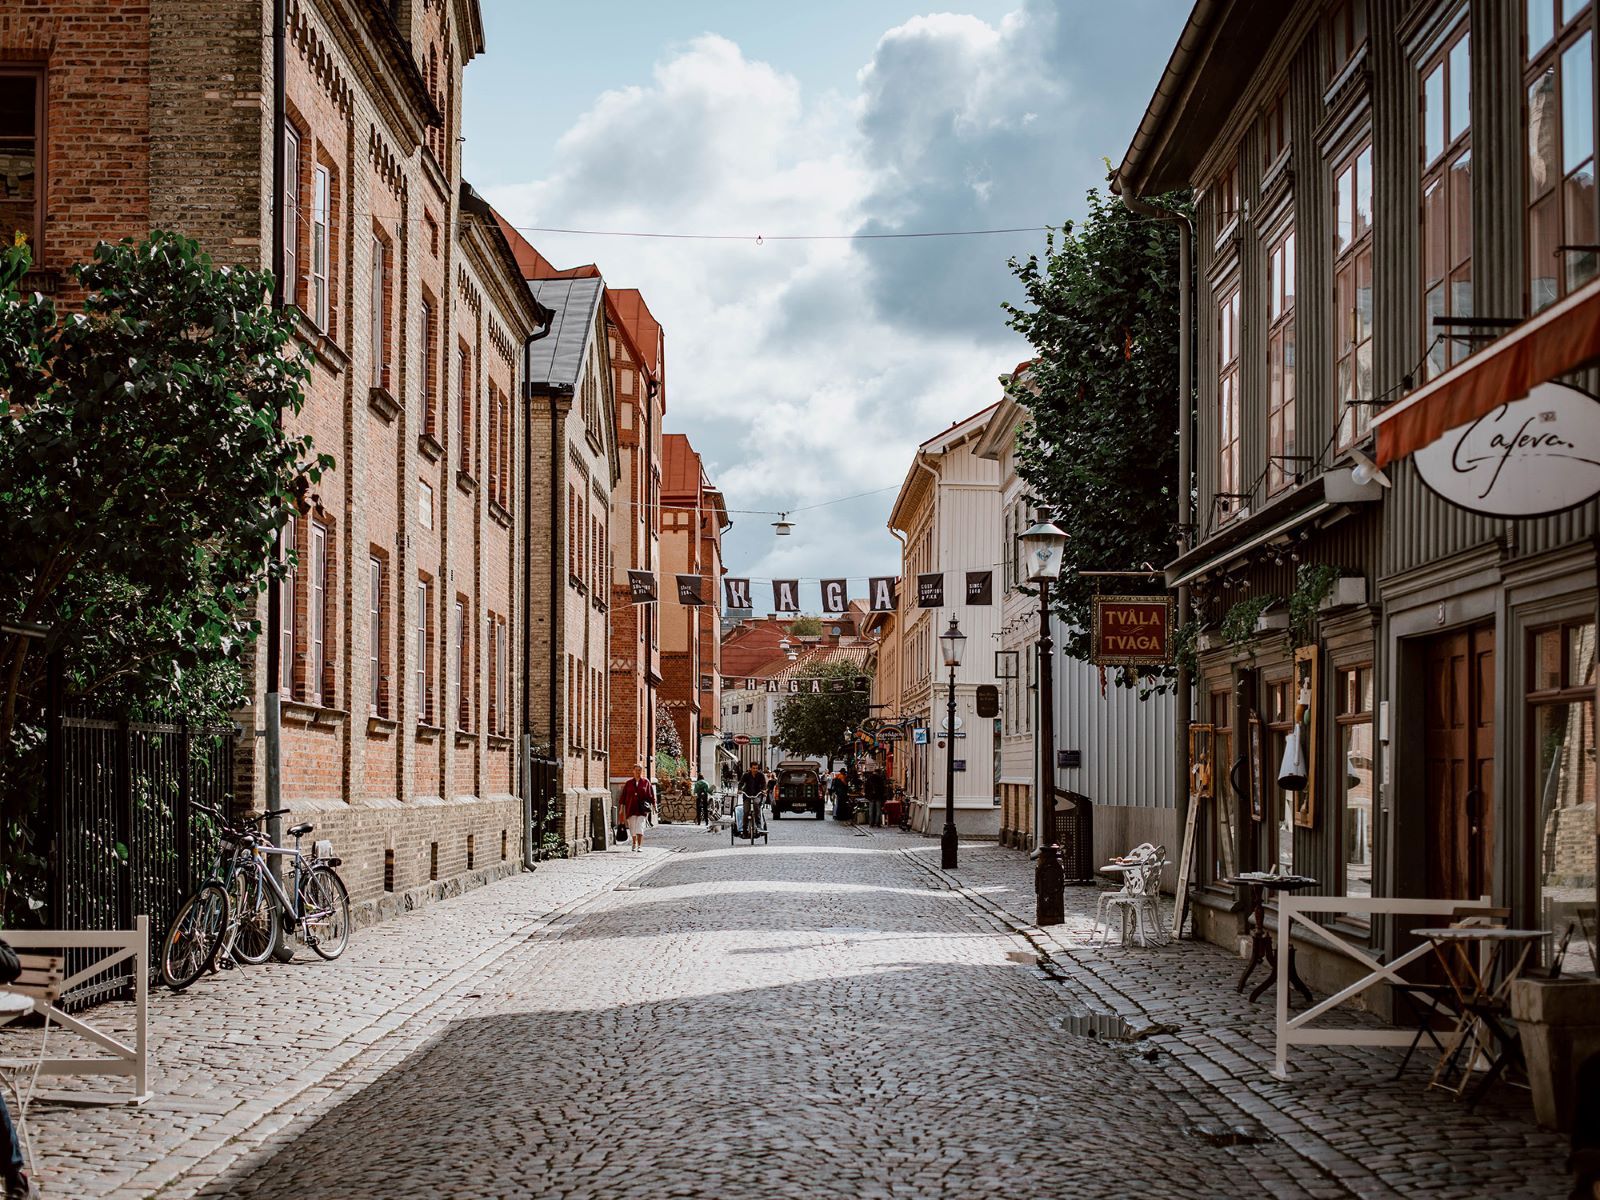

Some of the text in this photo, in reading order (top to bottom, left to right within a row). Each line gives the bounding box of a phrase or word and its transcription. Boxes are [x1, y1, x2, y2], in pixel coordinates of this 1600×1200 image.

[1105, 608, 1160, 625] TVÅLA
[1105, 636, 1160, 650] TVAGA
[747, 678, 820, 693] HAGA
